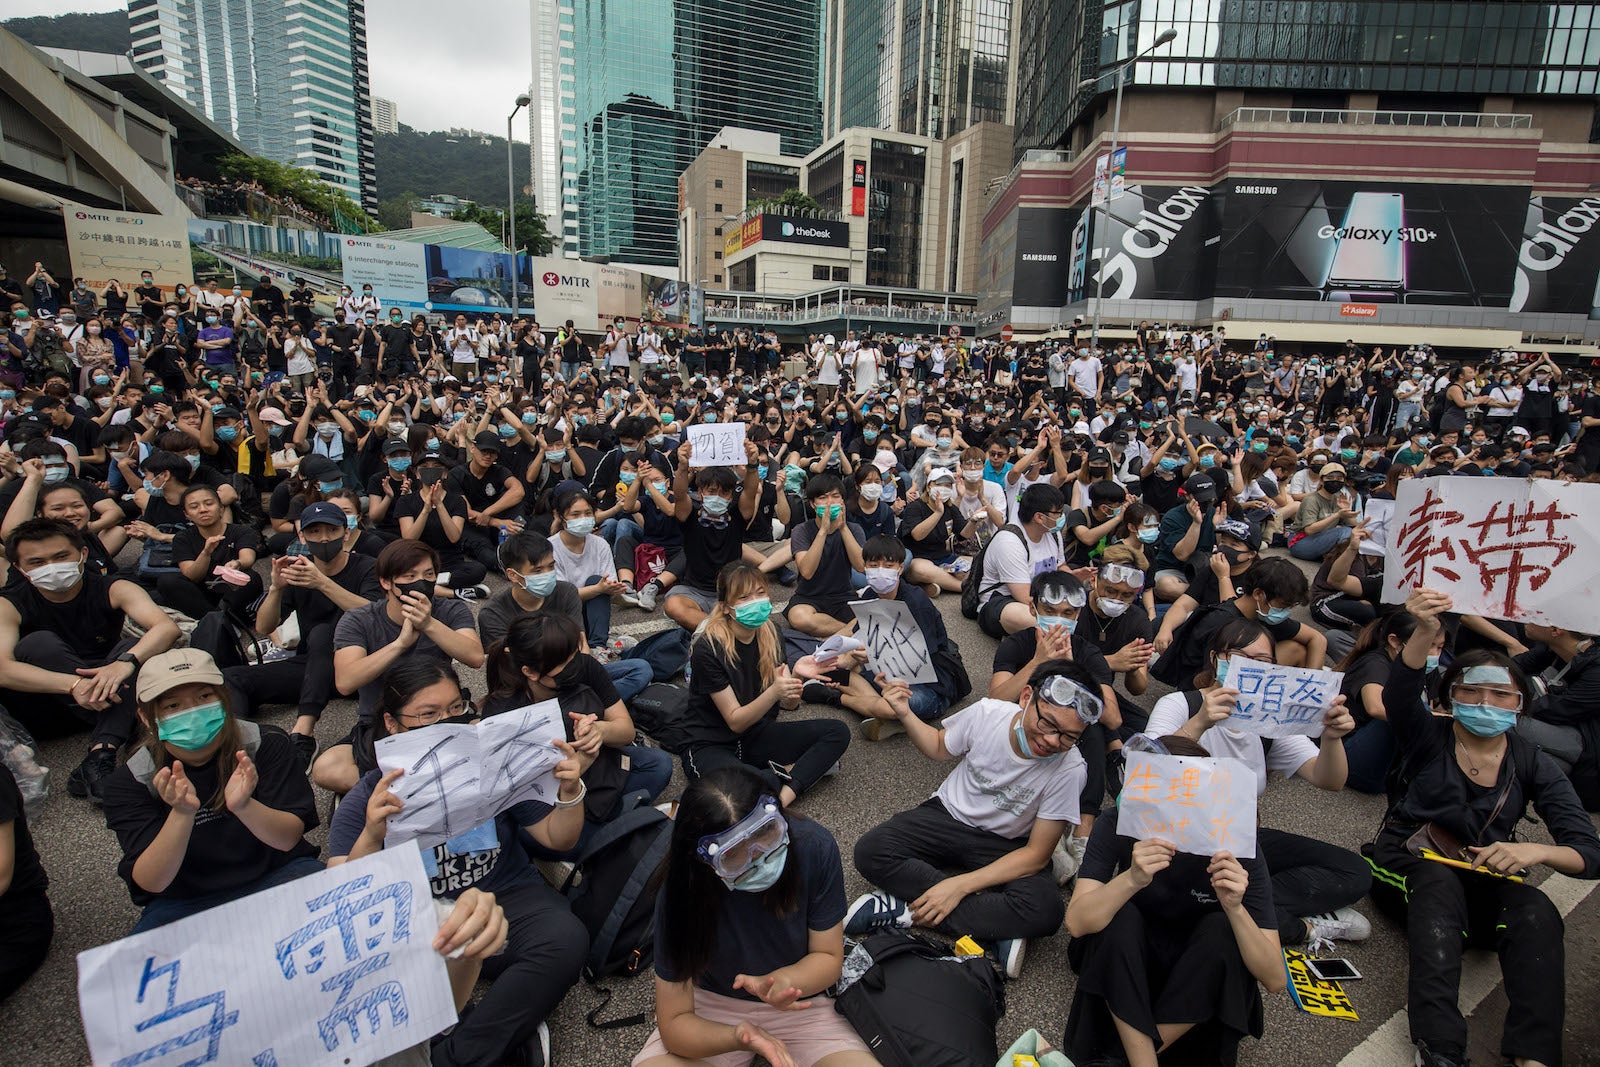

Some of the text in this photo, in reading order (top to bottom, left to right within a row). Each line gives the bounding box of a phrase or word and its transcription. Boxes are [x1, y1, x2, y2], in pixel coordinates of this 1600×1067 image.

[1234, 185, 1278, 195] SAMSUNG
[88, 214, 111, 222] MTR
[796, 227, 831, 240] theDesk
[1317, 224, 1438, 245] Galaxy S10+
[1022, 254, 1057, 262] SAMSUNG
[561, 275, 590, 288] MTR
[1350, 306, 1376, 317] Asiaray
[1396, 488, 1578, 618] 索帶
[1228, 666, 1328, 725] 頭盔
